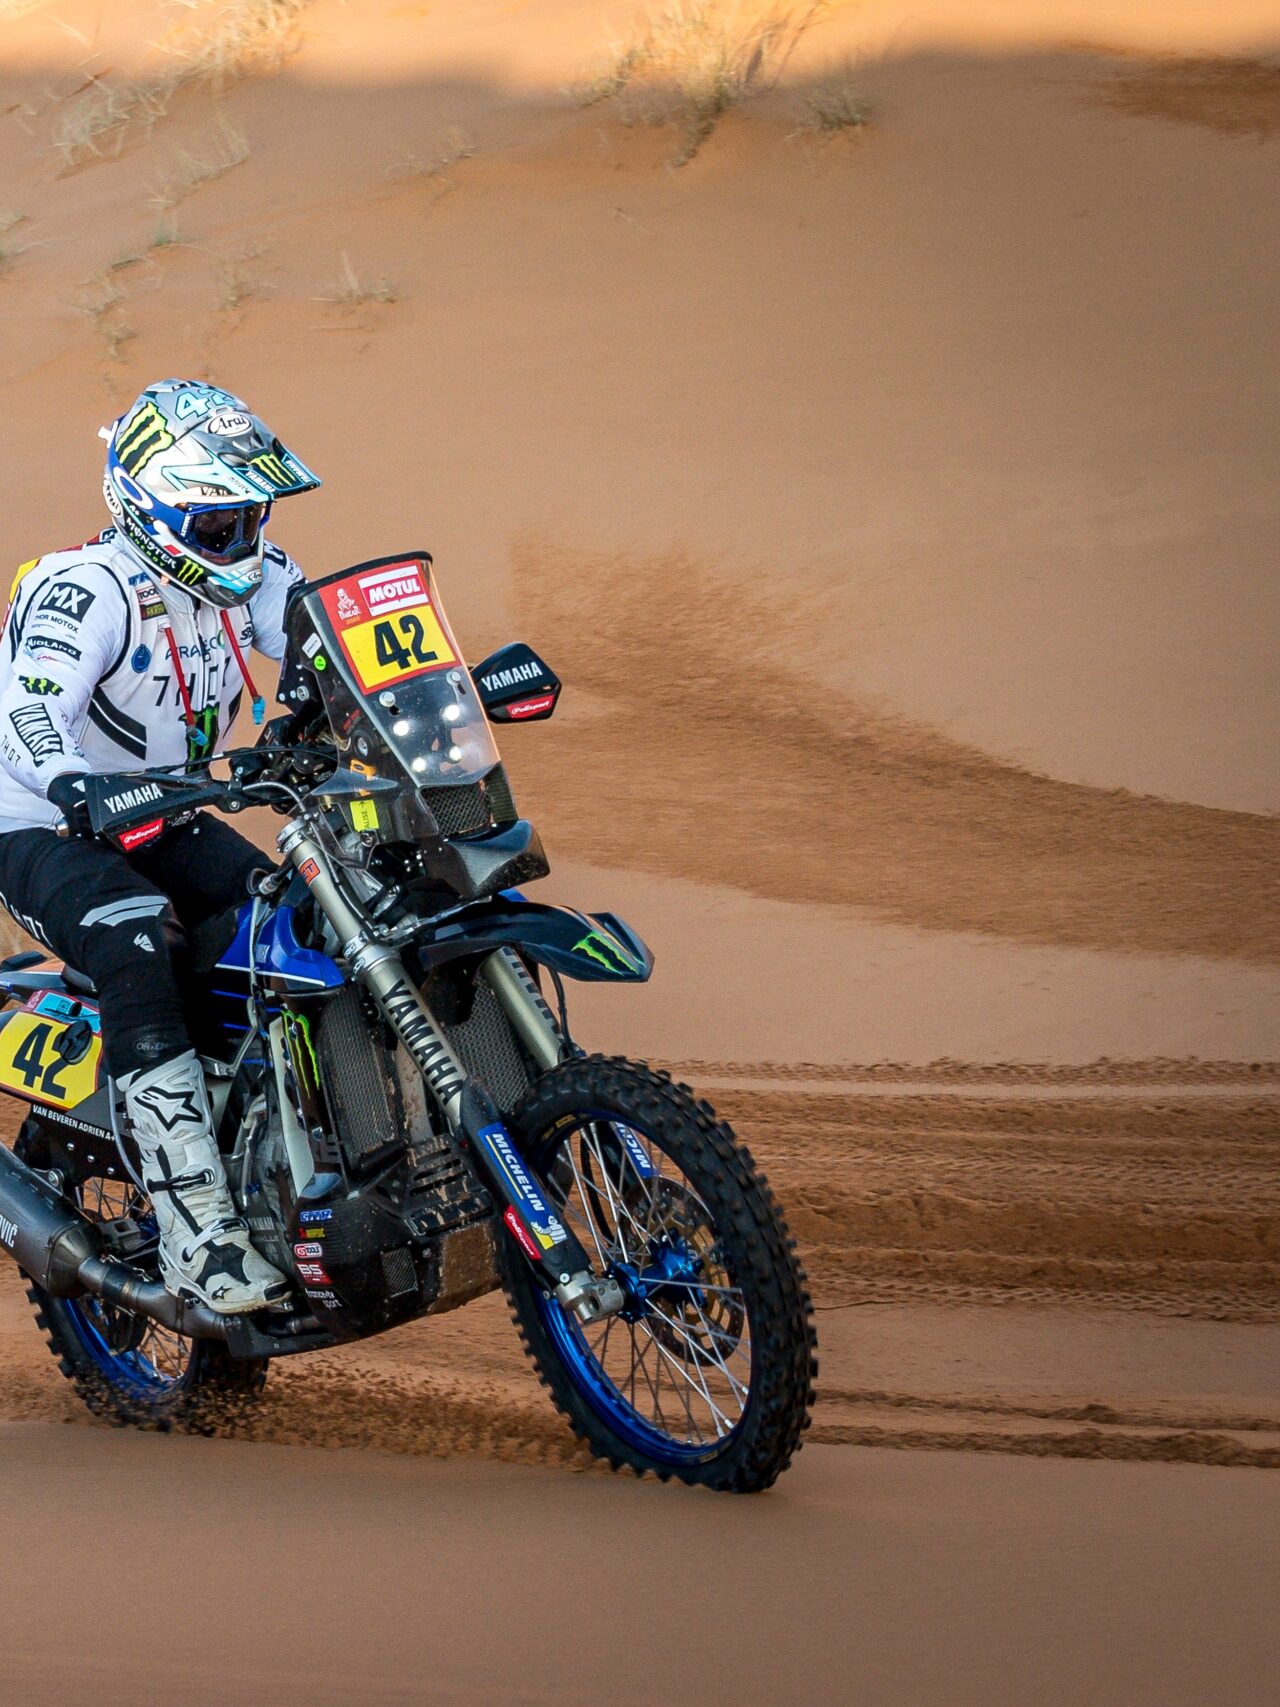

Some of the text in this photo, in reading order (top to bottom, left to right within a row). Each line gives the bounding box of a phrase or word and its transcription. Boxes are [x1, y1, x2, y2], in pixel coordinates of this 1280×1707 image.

[126, 517, 177, 569] MONSTER
[42, 585, 88, 615] MX
[369, 578, 421, 604] MOTUL
[373, 614, 438, 670] 42
[481, 661, 542, 692] YAMAHA
[104, 782, 164, 814] YAMAHA
[381, 979, 464, 1106] YAMAHA
[11, 1022, 72, 1100] 42
[32, 1104, 48, 1117] VAN
[47, 1109, 78, 1129] BEVEREN
[78, 1122, 105, 1139] ADRIEN
[492, 1133, 545, 1212] MICHELIN
[297, 1263, 323, 1275] BS
